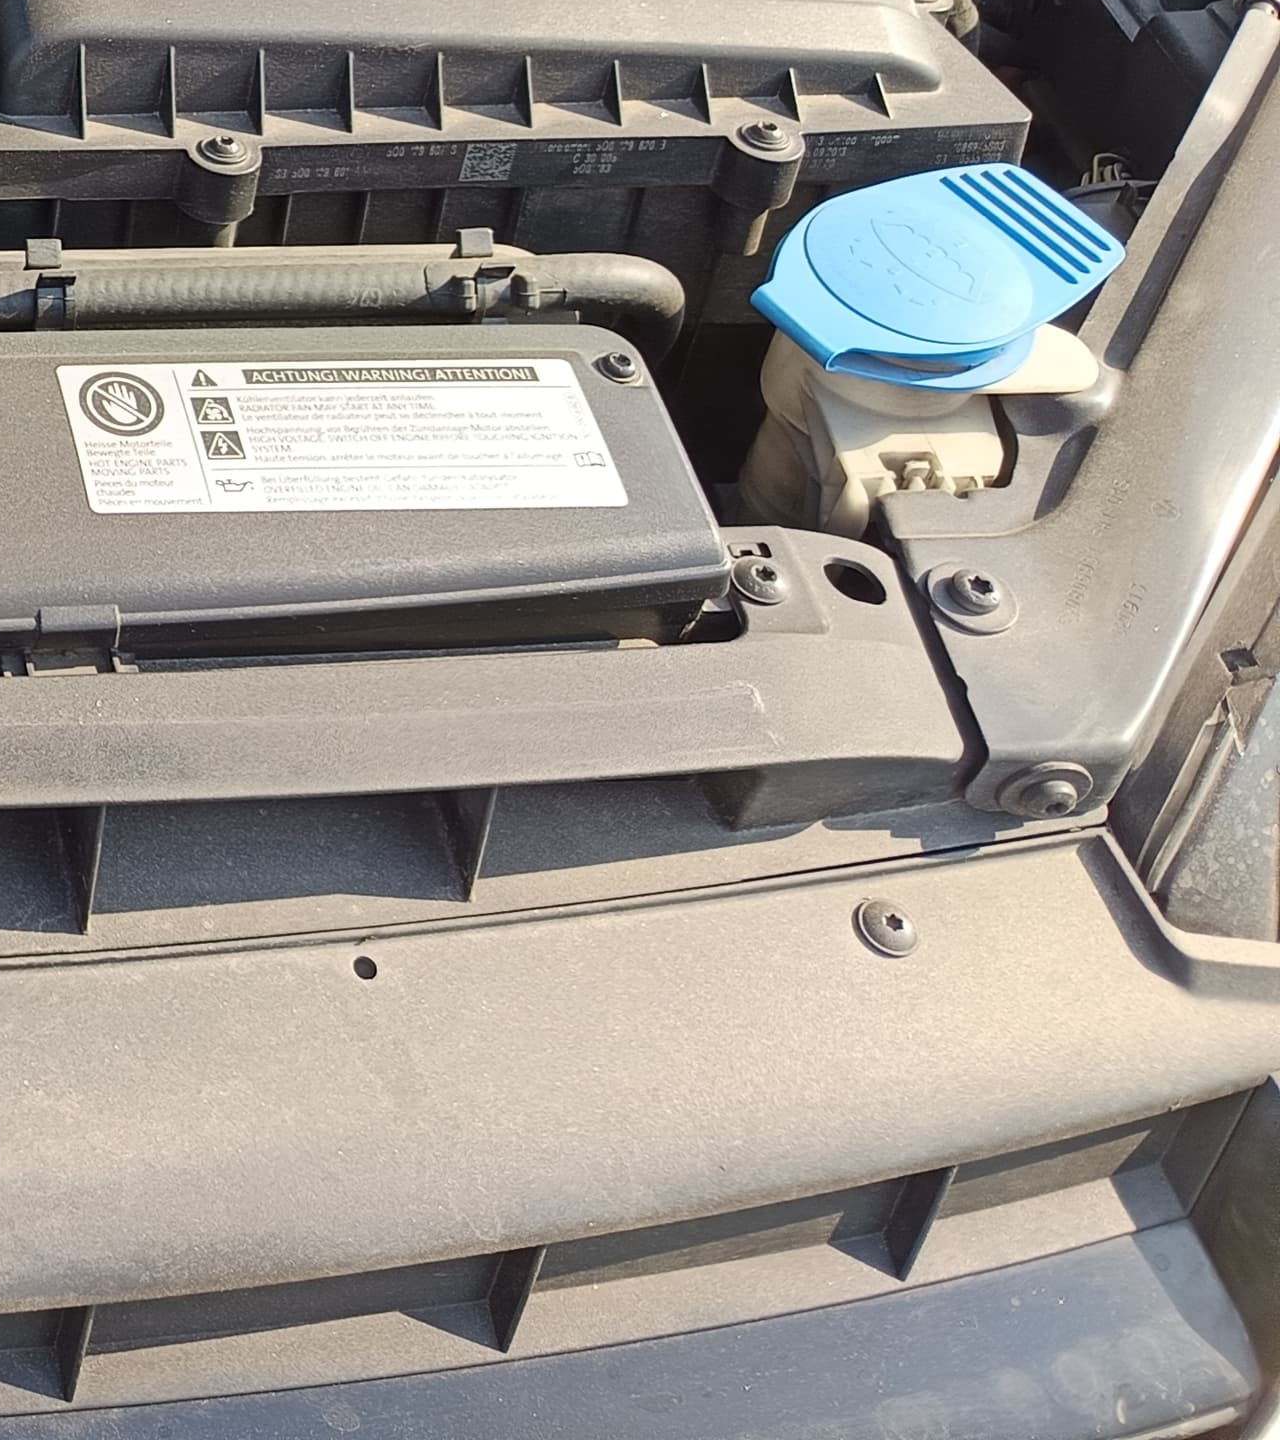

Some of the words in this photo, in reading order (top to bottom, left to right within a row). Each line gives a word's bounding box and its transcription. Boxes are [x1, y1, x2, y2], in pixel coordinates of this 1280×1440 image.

[252, 369, 338, 383] ACHTUNG!
[342, 368, 430, 382] WARNING!
[434, 367, 531, 381] ATTENTION!
[84, 440, 117, 449] Heisse
[119, 440, 173, 448] Motorteile
[86, 449, 131, 458] Bewegte
[89, 459, 110, 467] HOT
[114, 459, 152, 467] ENGINE
[157, 459, 188, 467] PARTS
[91, 468, 136, 476] MOVING
[139, 468, 170, 476] PARTS
[125, 479, 138, 487] du
[140, 479, 174, 487] moteur
[96, 488, 136, 496] chaudes
